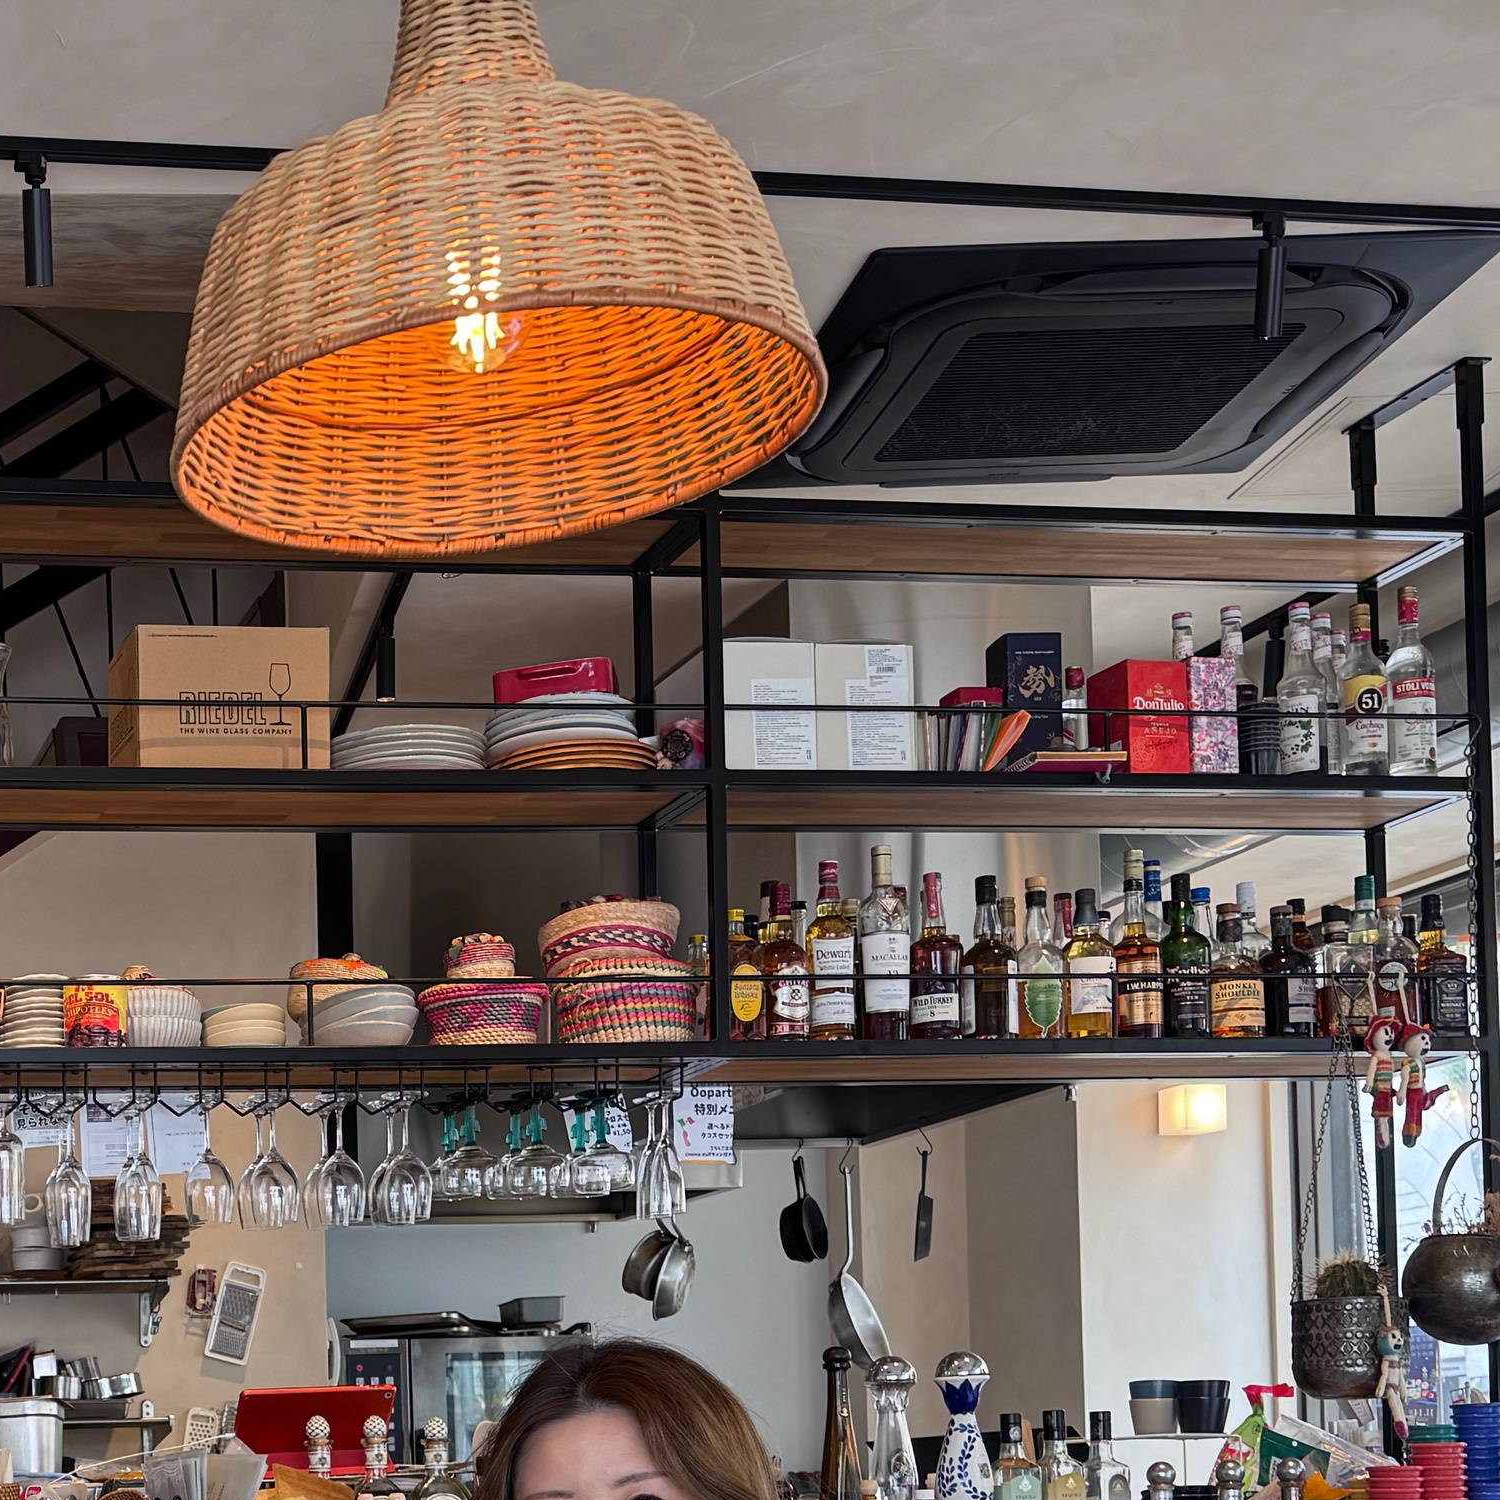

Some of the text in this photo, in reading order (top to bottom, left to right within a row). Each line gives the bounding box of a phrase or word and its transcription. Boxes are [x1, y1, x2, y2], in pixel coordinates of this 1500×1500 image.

[1396, 681, 1420, 693] STOLI
[179, 691, 266, 725] RIEDEL
[1361, 693, 1380, 709] 51
[1144, 726, 1177, 735] AÑEJO
